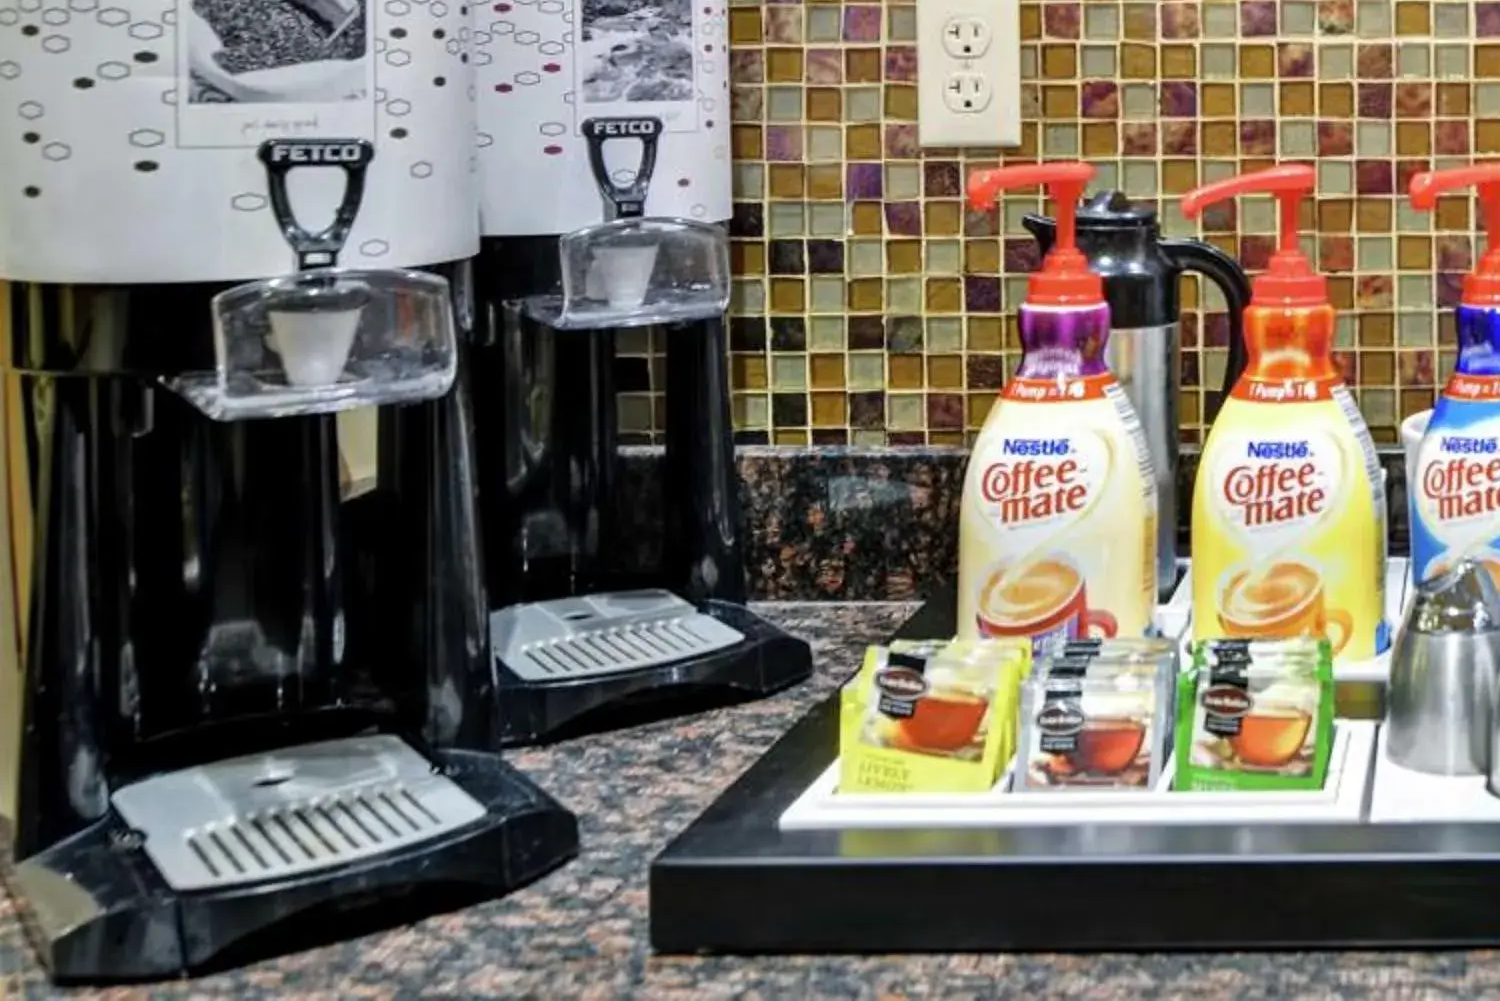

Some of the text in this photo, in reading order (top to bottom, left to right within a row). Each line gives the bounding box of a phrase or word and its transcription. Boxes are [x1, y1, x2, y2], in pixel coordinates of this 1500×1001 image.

[592, 120, 655, 134] FETCO
[271, 145, 361, 162] FETCO
[1002, 485, 1086, 523] mate
[1245, 488, 1325, 526] mate
